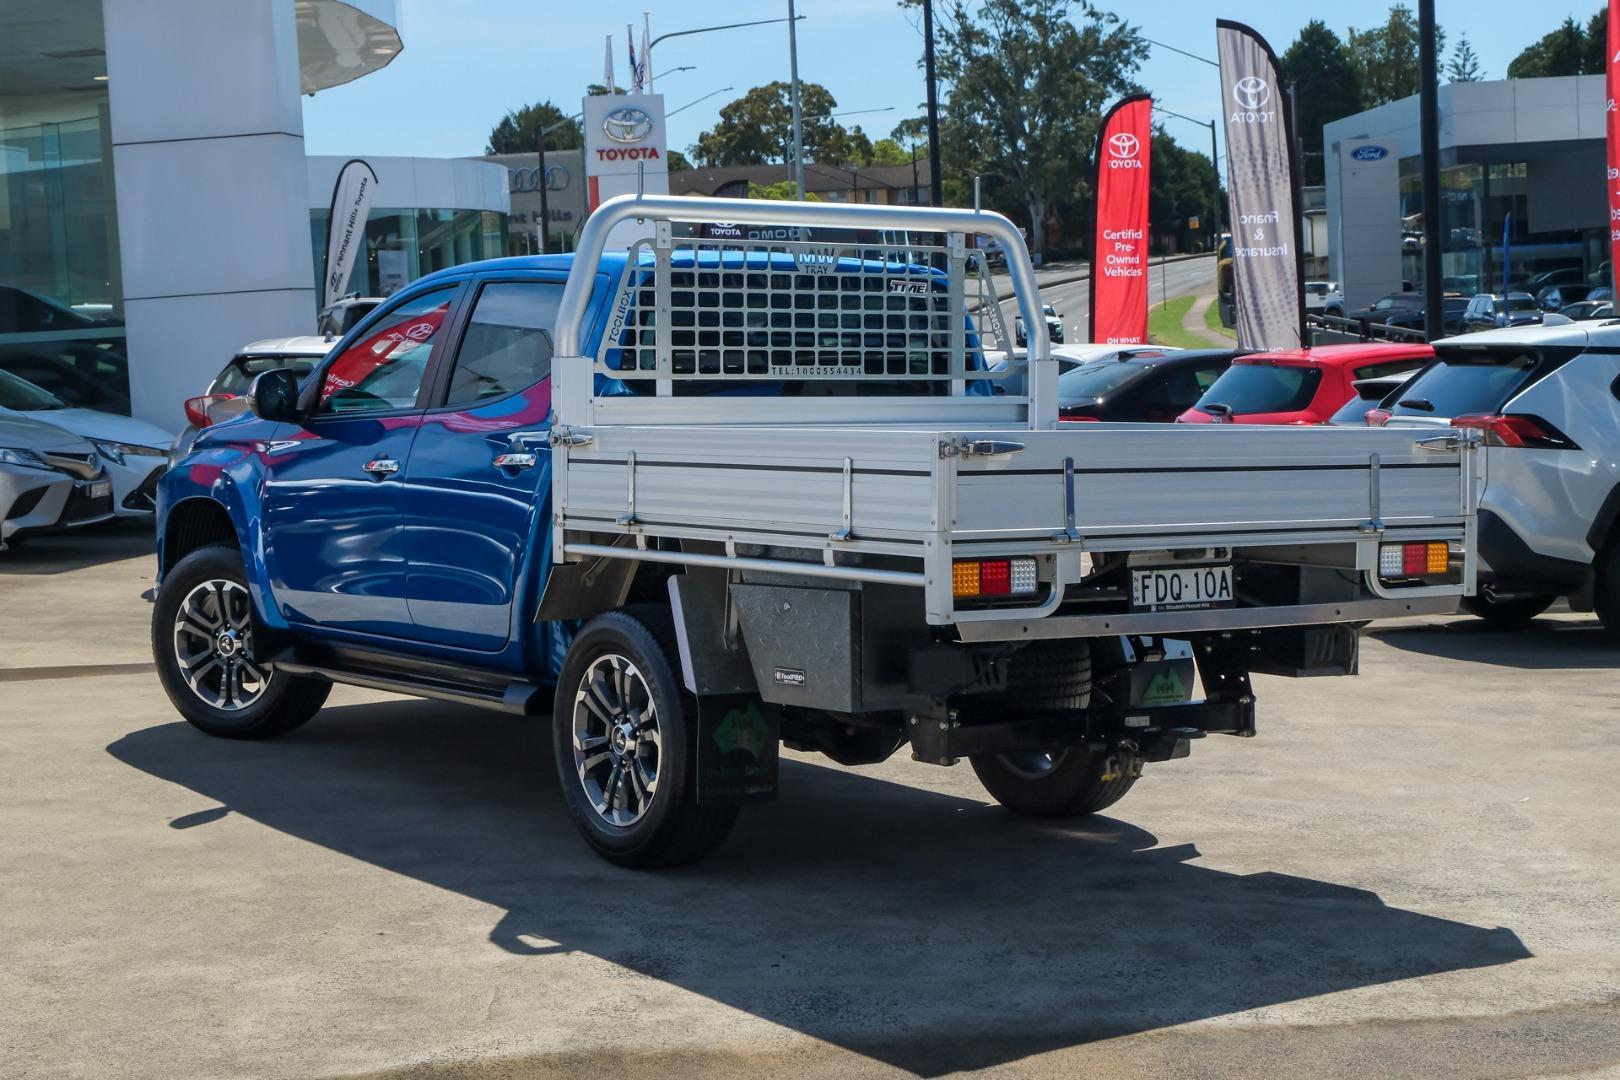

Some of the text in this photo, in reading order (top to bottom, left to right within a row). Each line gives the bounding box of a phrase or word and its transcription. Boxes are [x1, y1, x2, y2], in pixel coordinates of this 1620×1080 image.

[597, 147, 659, 161] TOYOTA
[1357, 148, 1381, 160] Ford
[1108, 160, 1142, 169] TOYOTA
[710, 228, 741, 236] TOYOTA
[1103, 229, 1142, 240] Certified
[1115, 242, 1135, 252] Pre-
[800, 247, 835, 264] MW
[1106, 254, 1140, 264] Owned
[805, 265, 828, 274] TRAY
[1104, 267, 1142, 277] Vehicles
[608, 289, 631, 342] TOOLBOX
[987, 300, 1005, 342] CANOPY
[1119, 336, 1140, 344] WHAT
